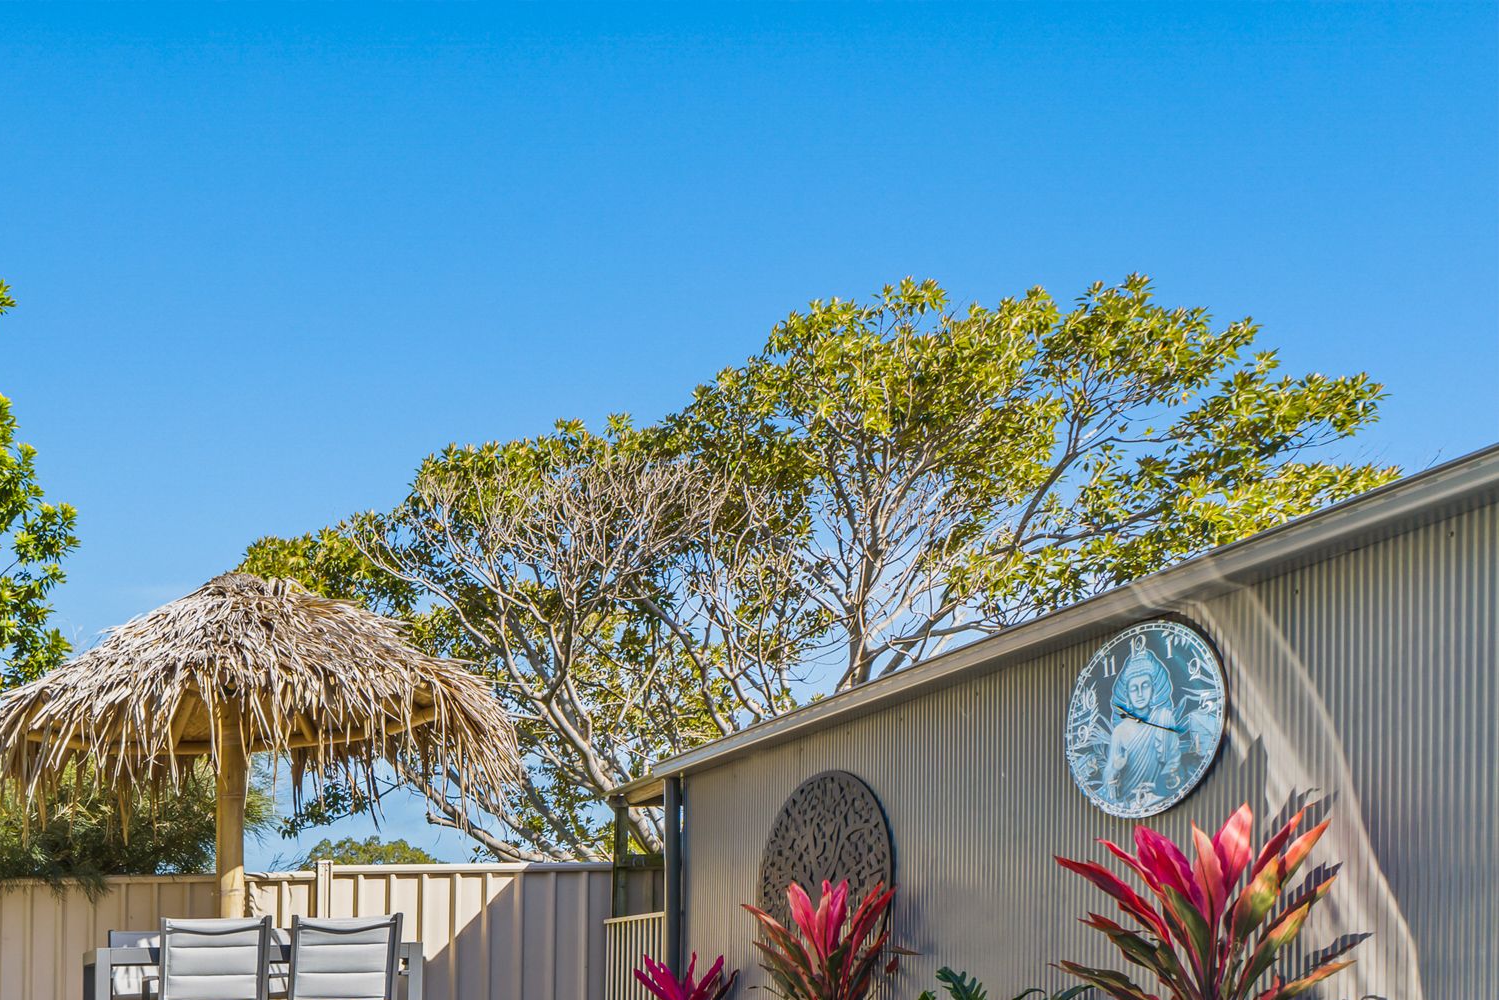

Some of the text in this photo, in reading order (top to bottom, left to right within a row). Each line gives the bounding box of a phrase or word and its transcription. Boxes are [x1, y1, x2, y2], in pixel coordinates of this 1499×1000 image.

[1130, 635, 1147, 658] 12
[1165, 637, 1173, 659] 1
[1102, 655, 1116, 678] 11
[1187, 657, 1201, 681] 2
[1077, 725, 1089, 745] 9
